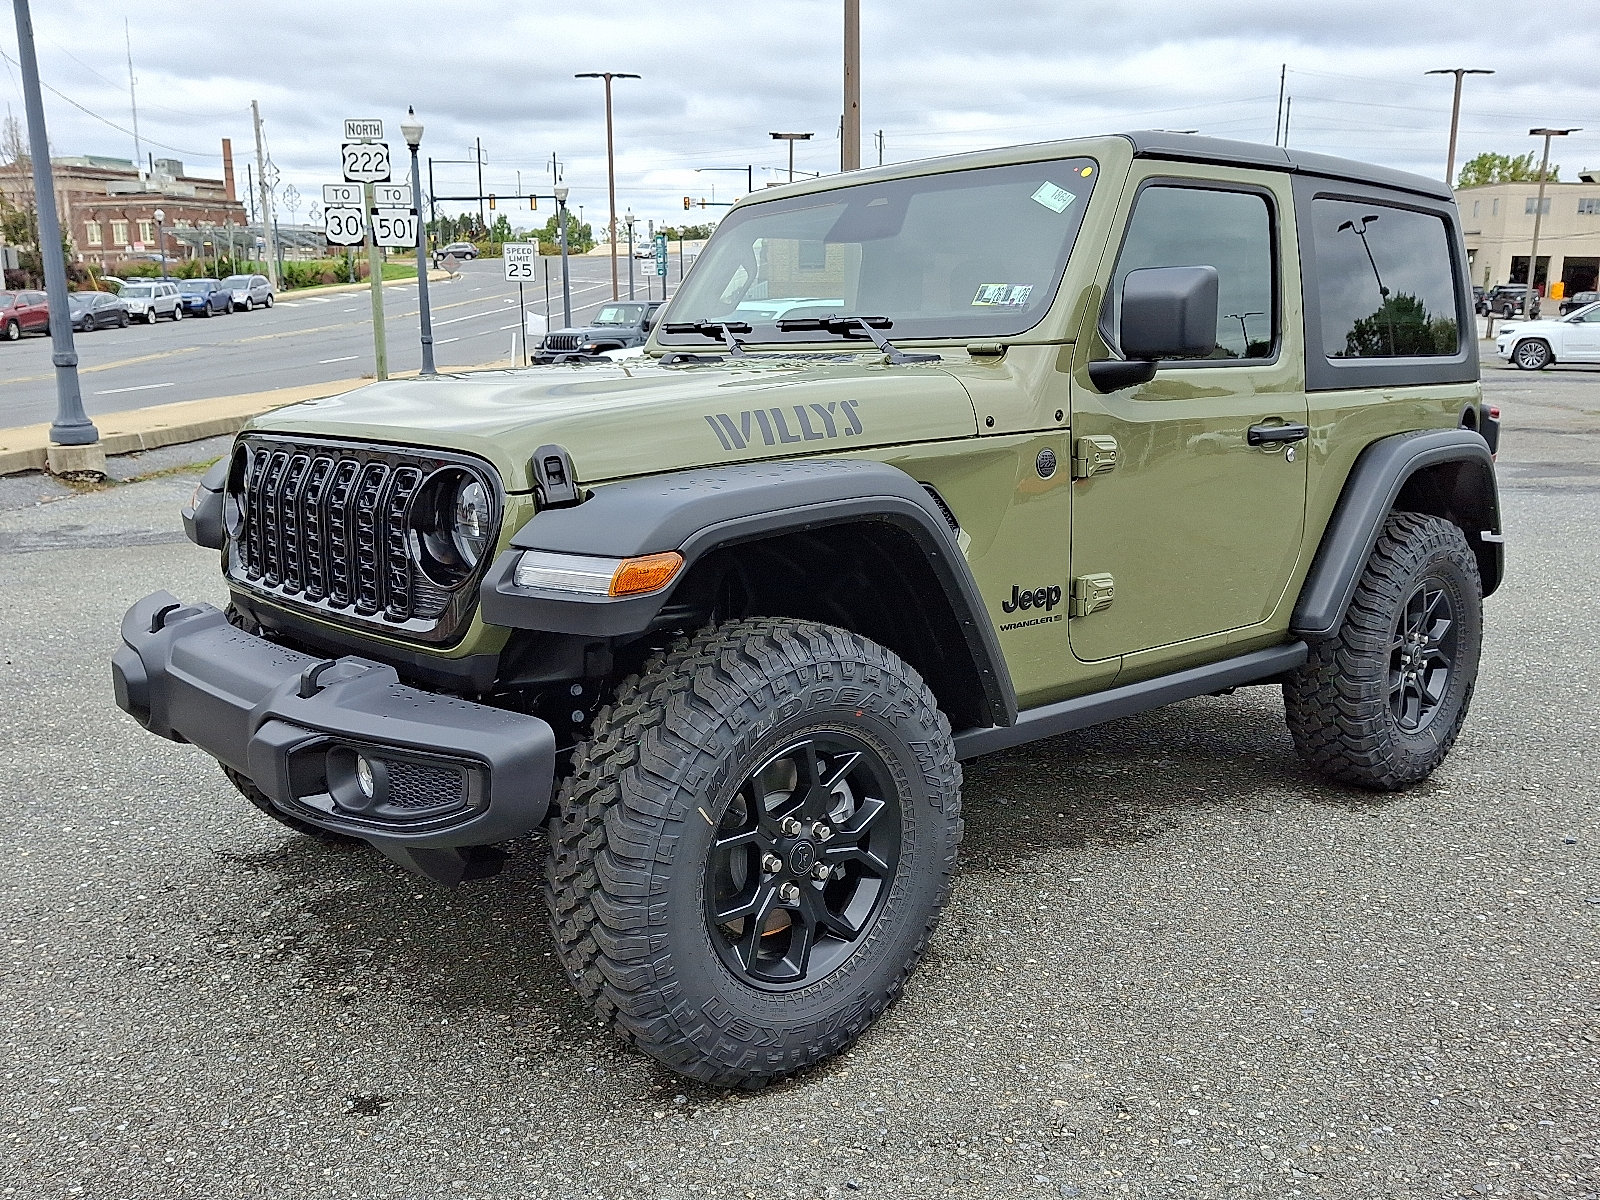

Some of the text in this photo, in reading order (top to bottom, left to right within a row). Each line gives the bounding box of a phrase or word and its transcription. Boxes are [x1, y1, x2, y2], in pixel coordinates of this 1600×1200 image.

[348, 123, 380, 136] NORTH
[348, 152, 386, 173] 222
[333, 189, 351, 200] TO
[384, 190, 401, 201] TO
[330, 216, 359, 236] 30
[380, 219, 413, 239] 501
[506, 247, 532, 255] SPEED
[508, 263, 532, 277] 25
[704, 399, 863, 451] WILLYS
[1002, 584, 1062, 614] Jeep
[1000, 616, 1053, 632] WRANGLER
[705, 685, 910, 807] WILDPEAK
